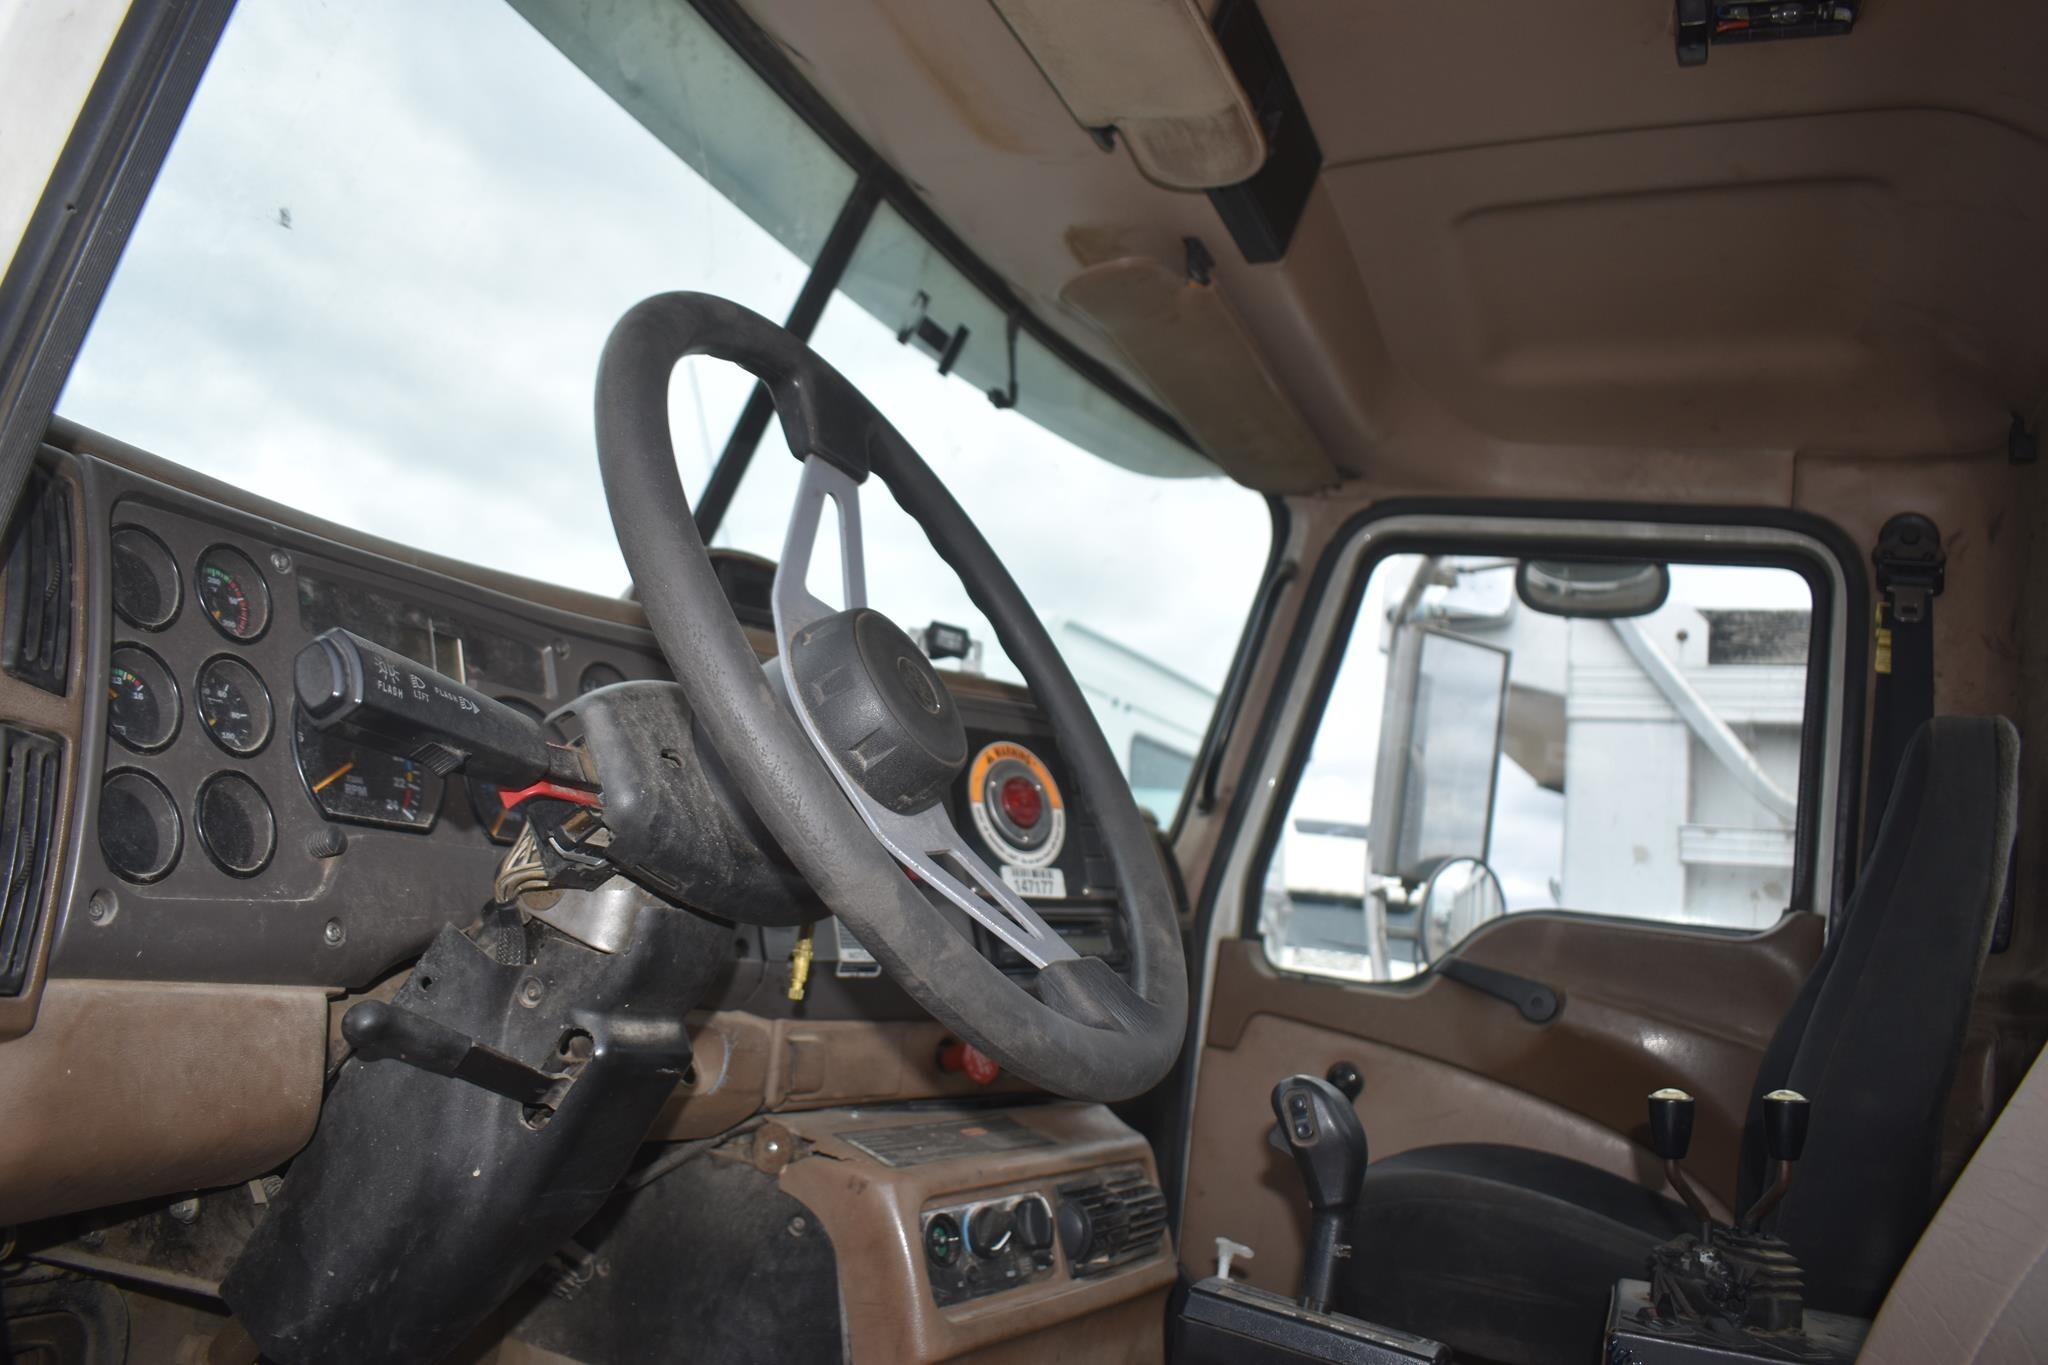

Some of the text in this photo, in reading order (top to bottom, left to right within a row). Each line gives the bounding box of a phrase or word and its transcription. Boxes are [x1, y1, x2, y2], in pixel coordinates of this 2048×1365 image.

[377, 680, 403, 699] FLASH
[413, 690, 430, 702] LIFT
[434, 687, 459, 702] FLASH
